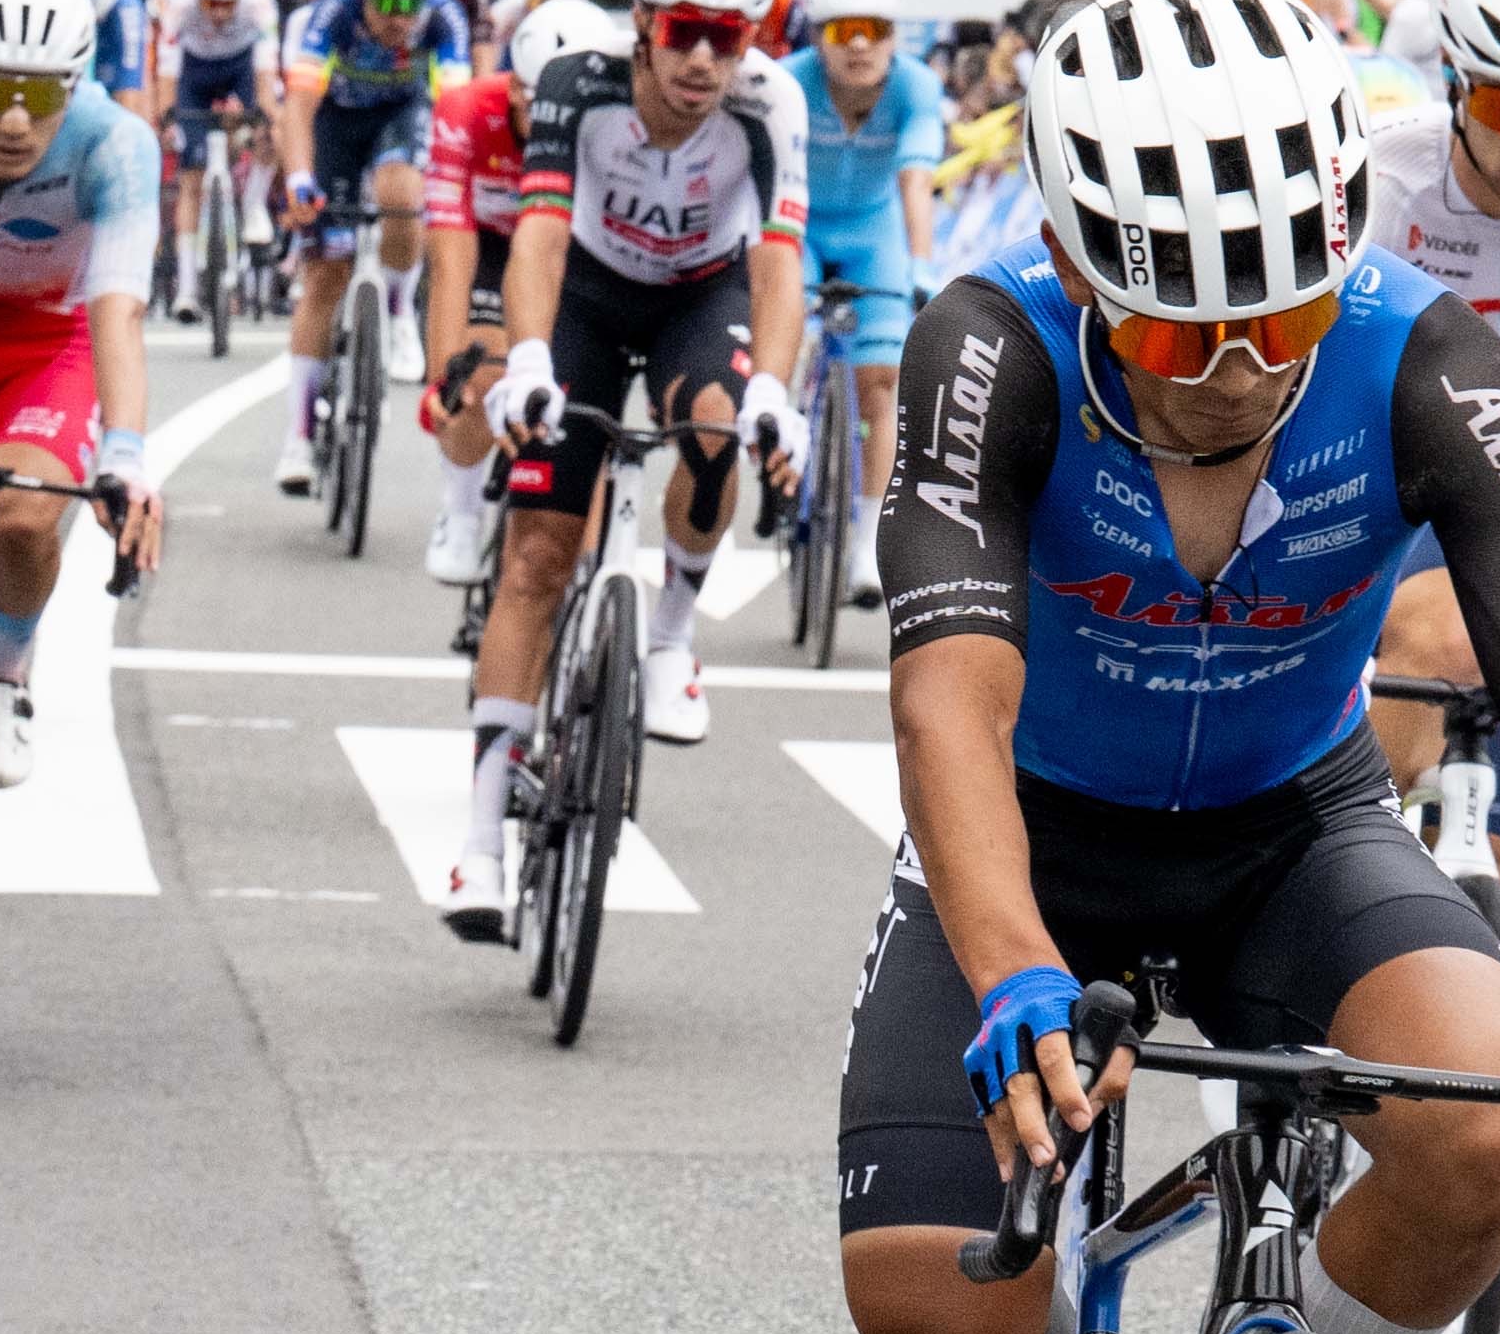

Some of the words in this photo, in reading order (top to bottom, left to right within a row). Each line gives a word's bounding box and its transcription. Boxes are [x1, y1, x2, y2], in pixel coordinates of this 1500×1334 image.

[603, 189, 710, 235] UAE
[916, 333, 1004, 549] Aisan
[1091, 518, 1153, 558] CEMA
[1145, 653, 1307, 693] MAXXIS
